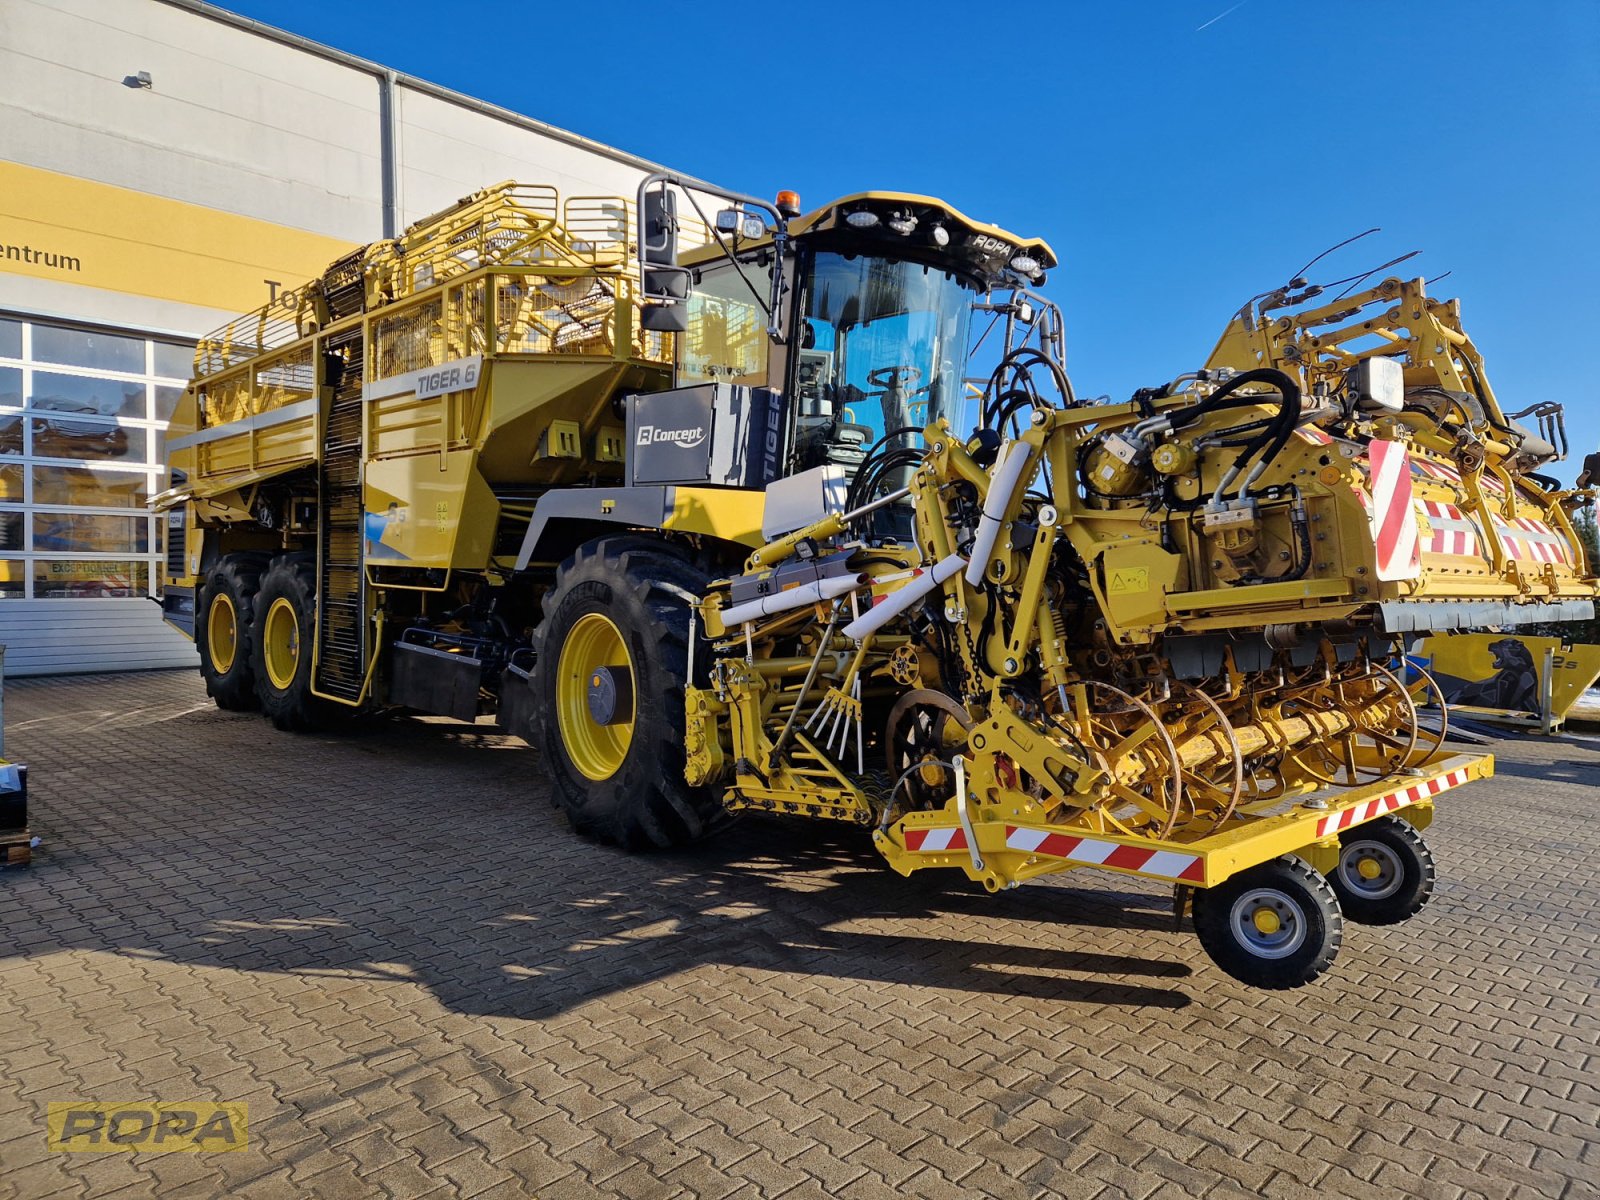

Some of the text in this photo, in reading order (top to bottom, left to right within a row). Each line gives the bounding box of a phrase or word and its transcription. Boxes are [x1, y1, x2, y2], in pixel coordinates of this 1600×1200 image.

[973, 235, 1011, 257] ROPA
[418, 363, 476, 393] TIGER 6
[654, 427, 703, 442] Concept
[763, 388, 781, 480] TIGER
